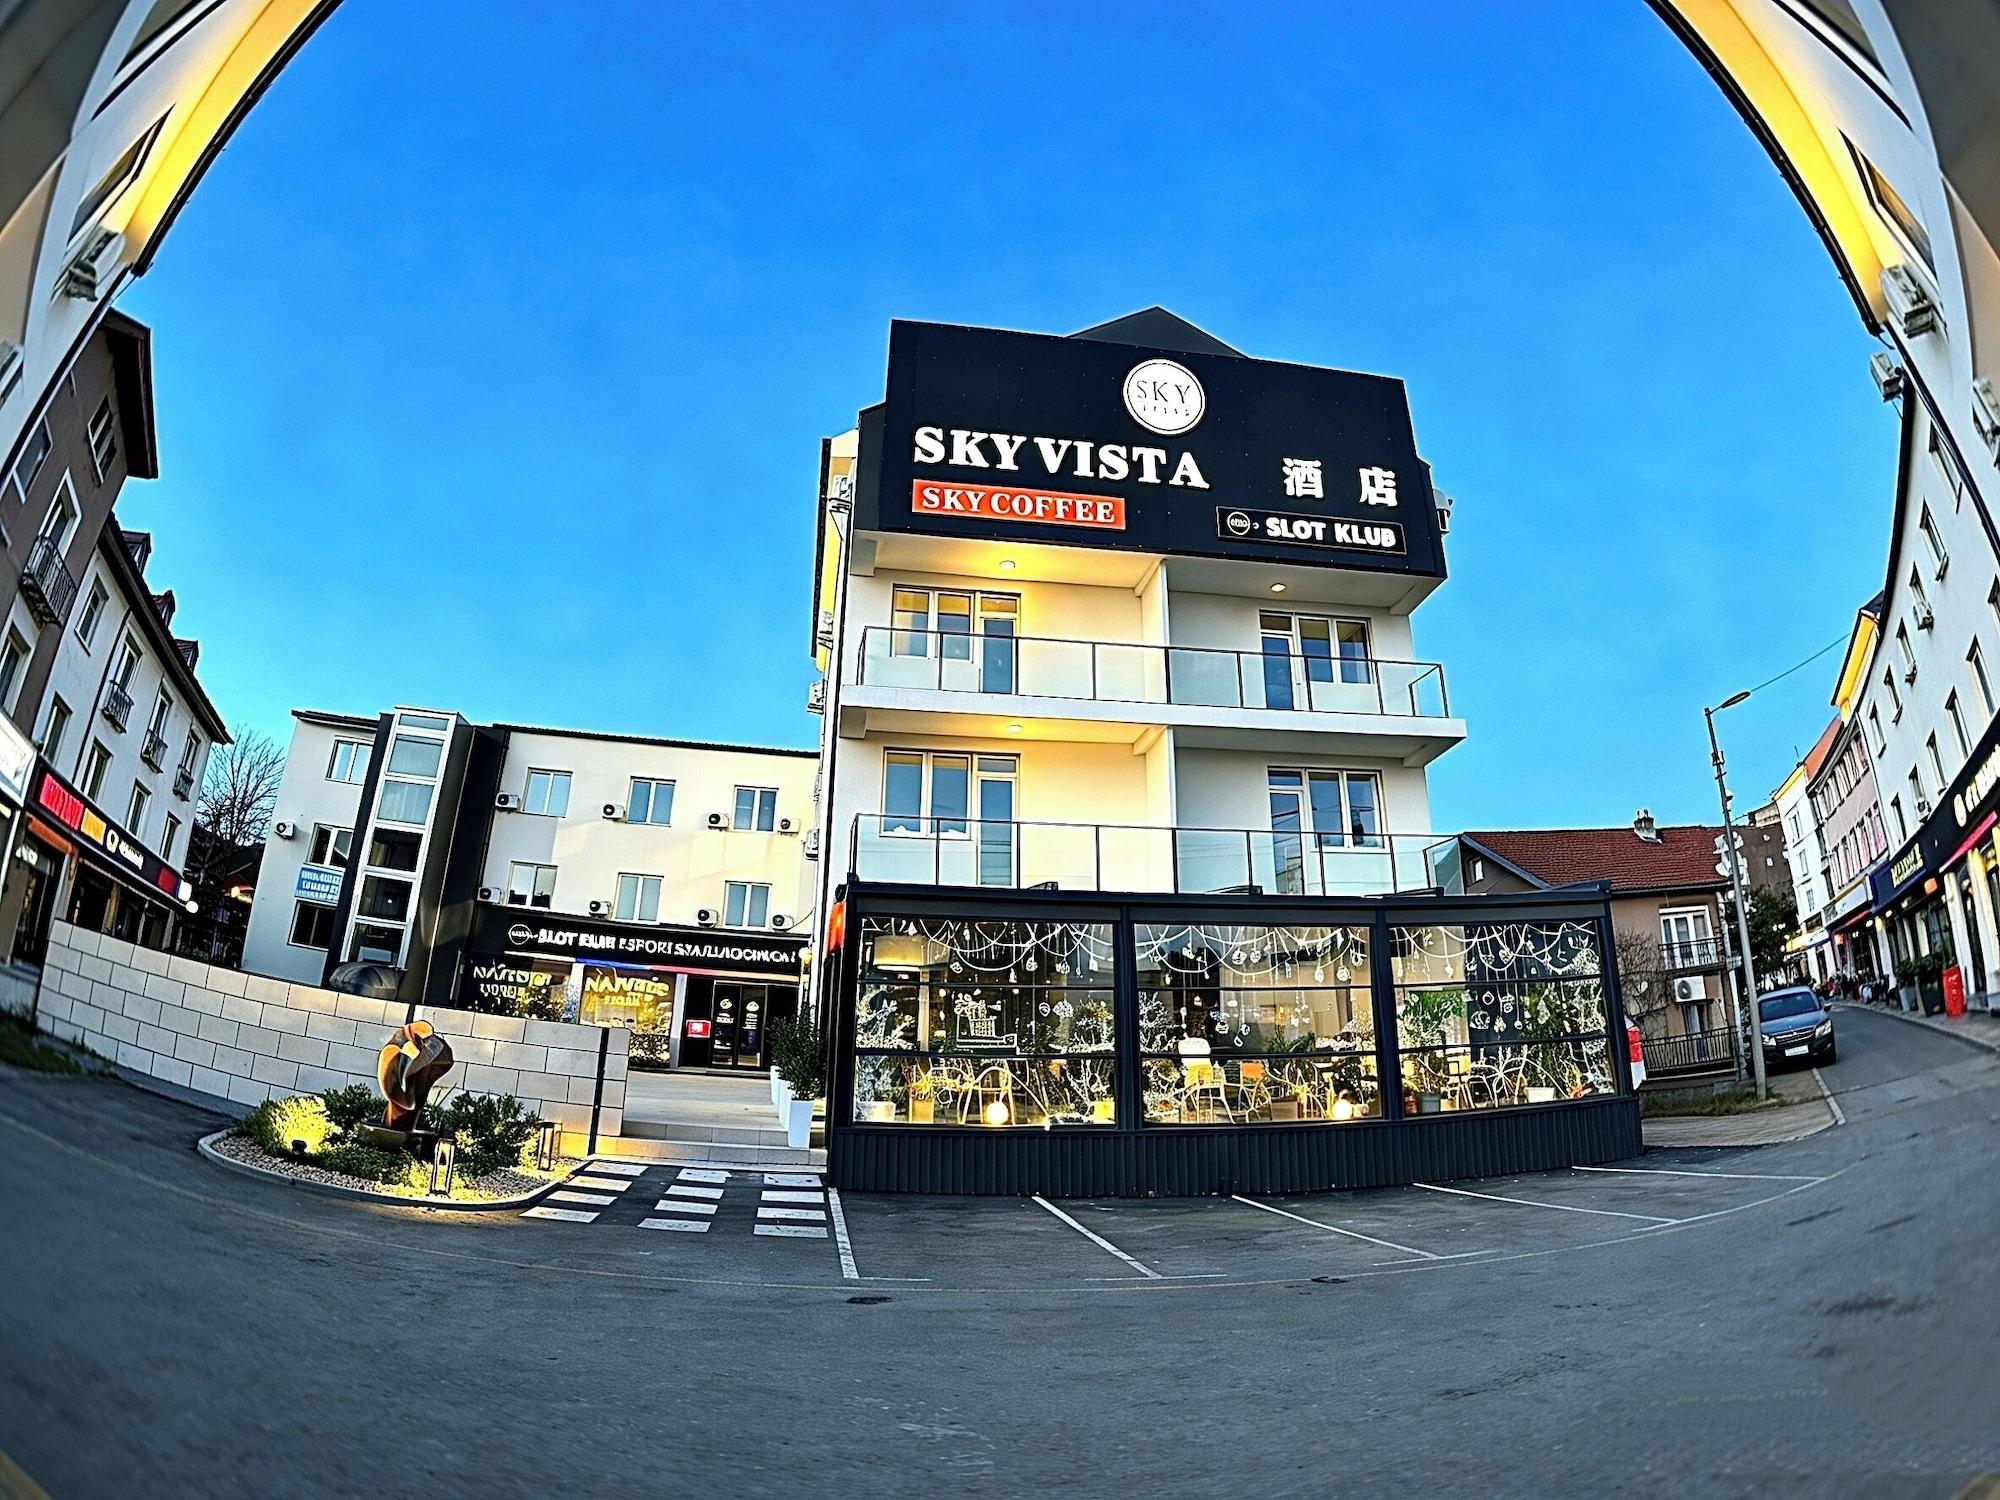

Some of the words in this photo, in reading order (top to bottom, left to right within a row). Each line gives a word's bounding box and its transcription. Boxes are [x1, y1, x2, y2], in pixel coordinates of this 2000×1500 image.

[1136, 380, 1191, 404] SKY
[913, 426, 1027, 471] SKY
[1033, 436, 1210, 489] VISTA
[1282, 457, 1398, 507] 酒店
[922, 487, 986, 512] SKY
[990, 493, 1116, 523] COFFEE
[1265, 517, 1327, 541] SLOT
[1334, 522, 1397, 548] KLUB
